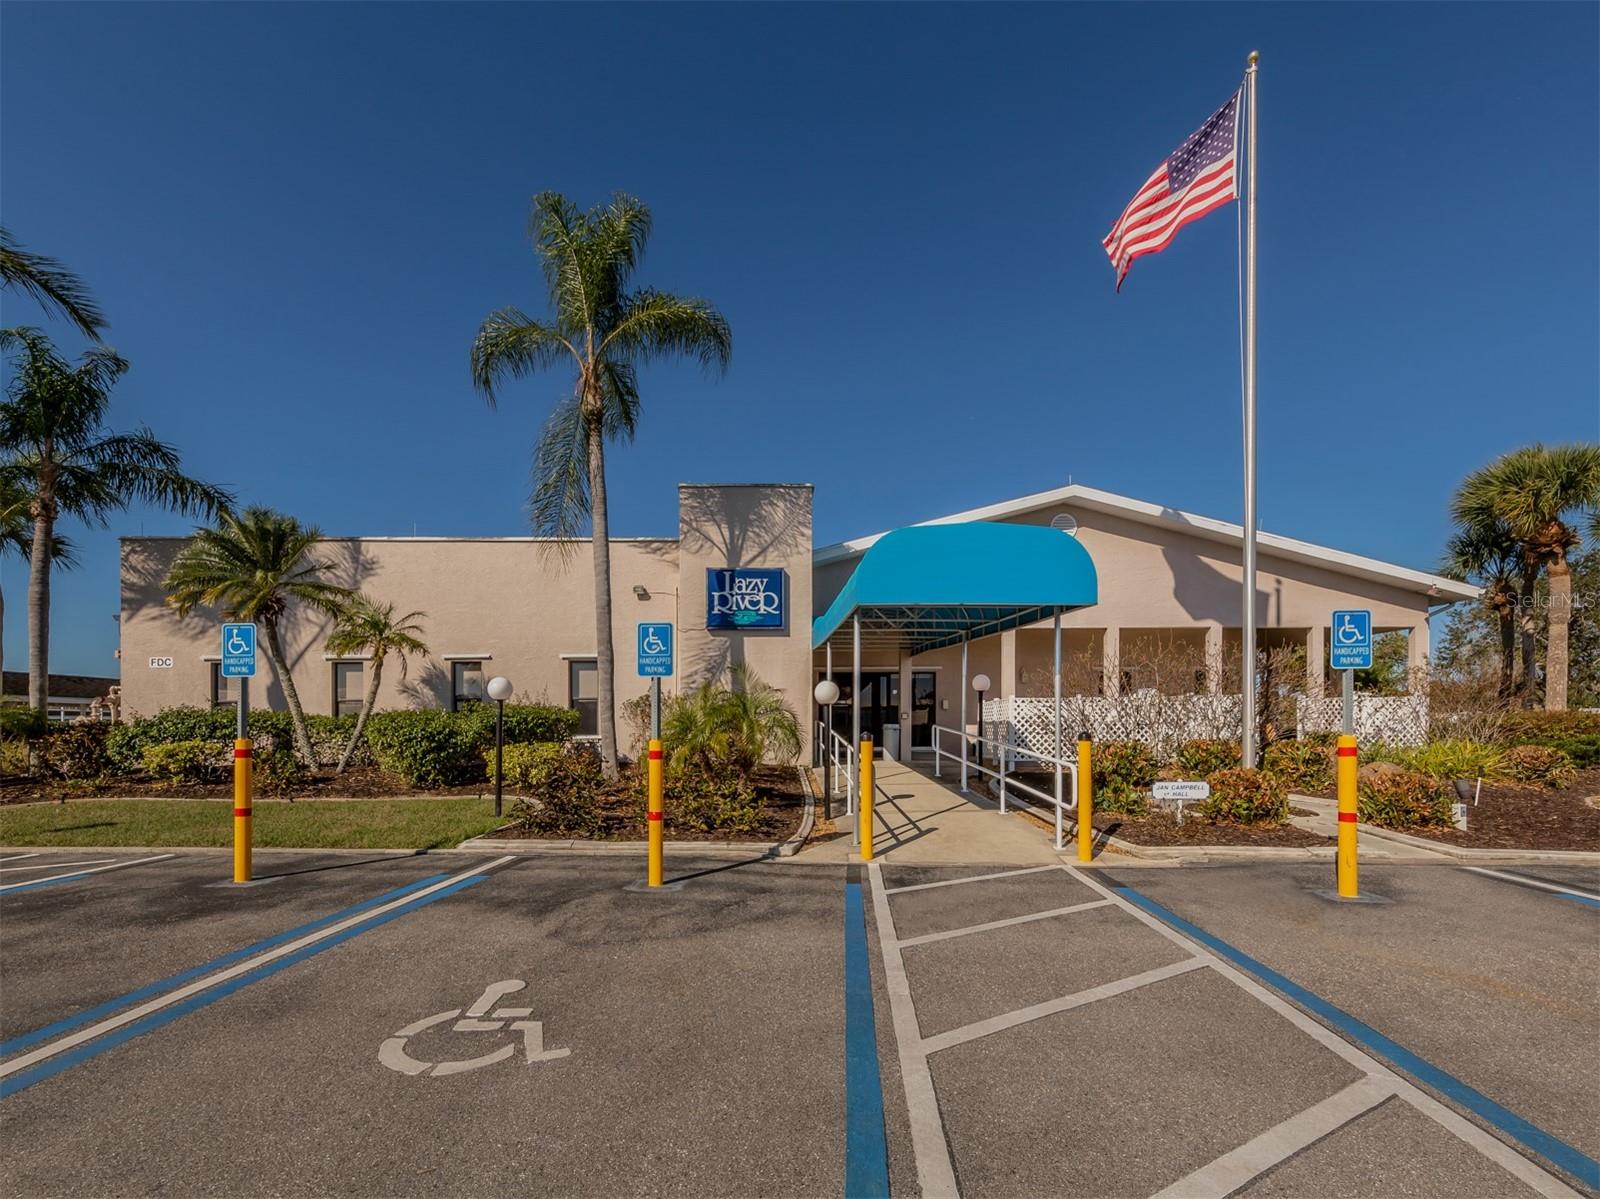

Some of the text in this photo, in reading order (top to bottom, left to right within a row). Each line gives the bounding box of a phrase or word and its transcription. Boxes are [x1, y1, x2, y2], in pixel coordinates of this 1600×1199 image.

[723, 571, 768, 593] Lazy
[1334, 647, 1369, 655] HANDICAPPED
[151, 657, 171, 666] FDC
[224, 657, 254, 665] HANDICAPPED
[640, 657, 671, 665] HANDICAPPED
[1340, 656, 1363, 665] PARKING
